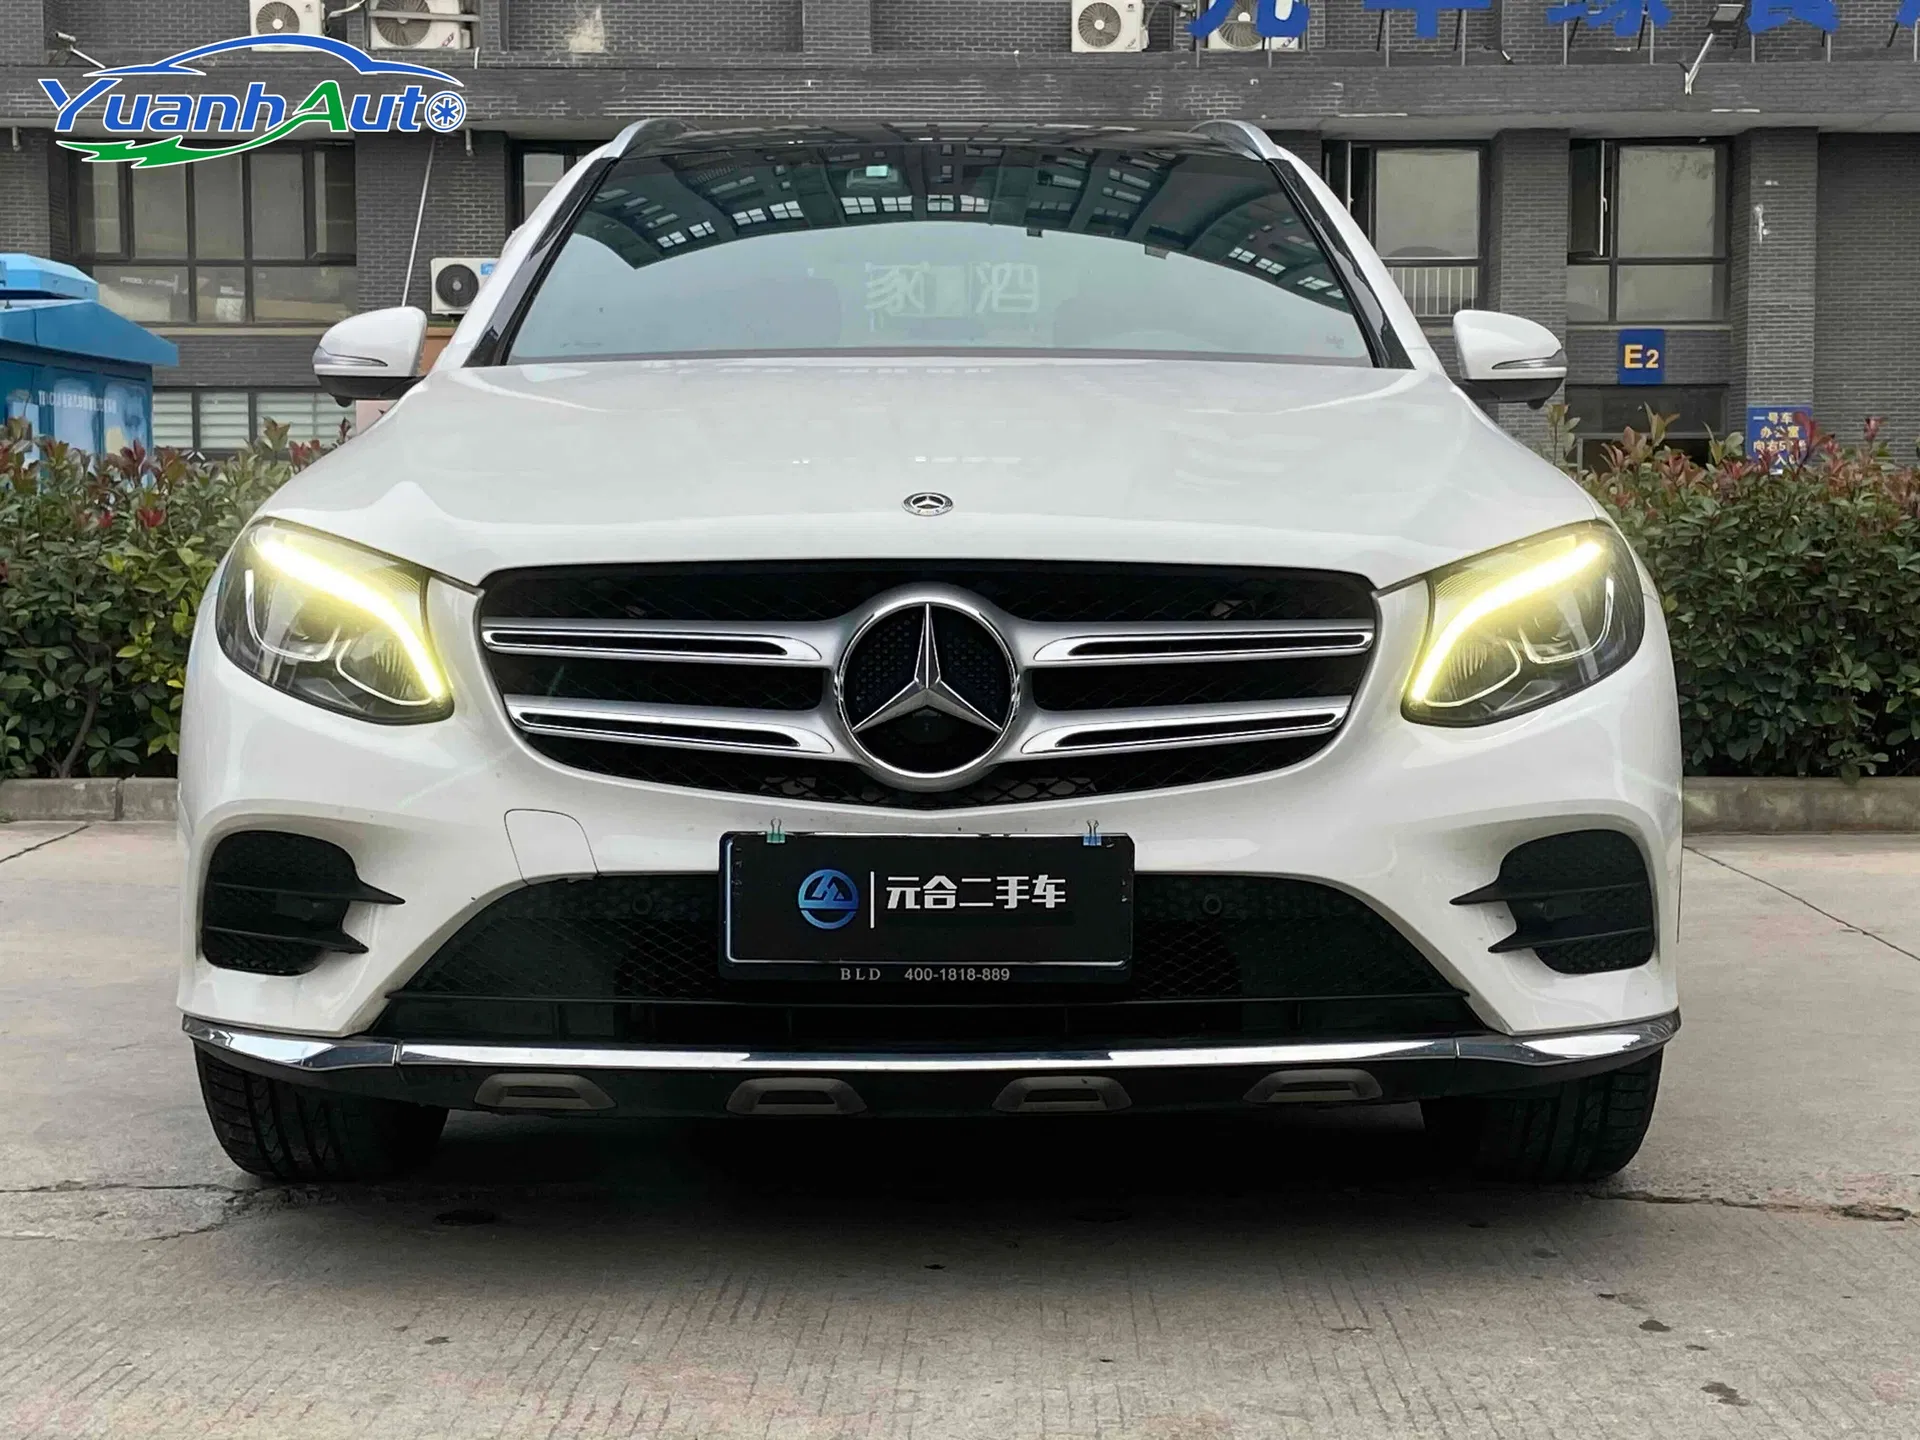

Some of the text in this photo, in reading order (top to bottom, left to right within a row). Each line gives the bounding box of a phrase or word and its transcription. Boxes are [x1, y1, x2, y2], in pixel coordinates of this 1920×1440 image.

[1624, 344, 1660, 369] E2
[1753, 412, 1806, 425] 一号车
[886, 874, 1067, 909] 元合二手车
[840, 968, 1010, 981] BLD 400-1818-889
